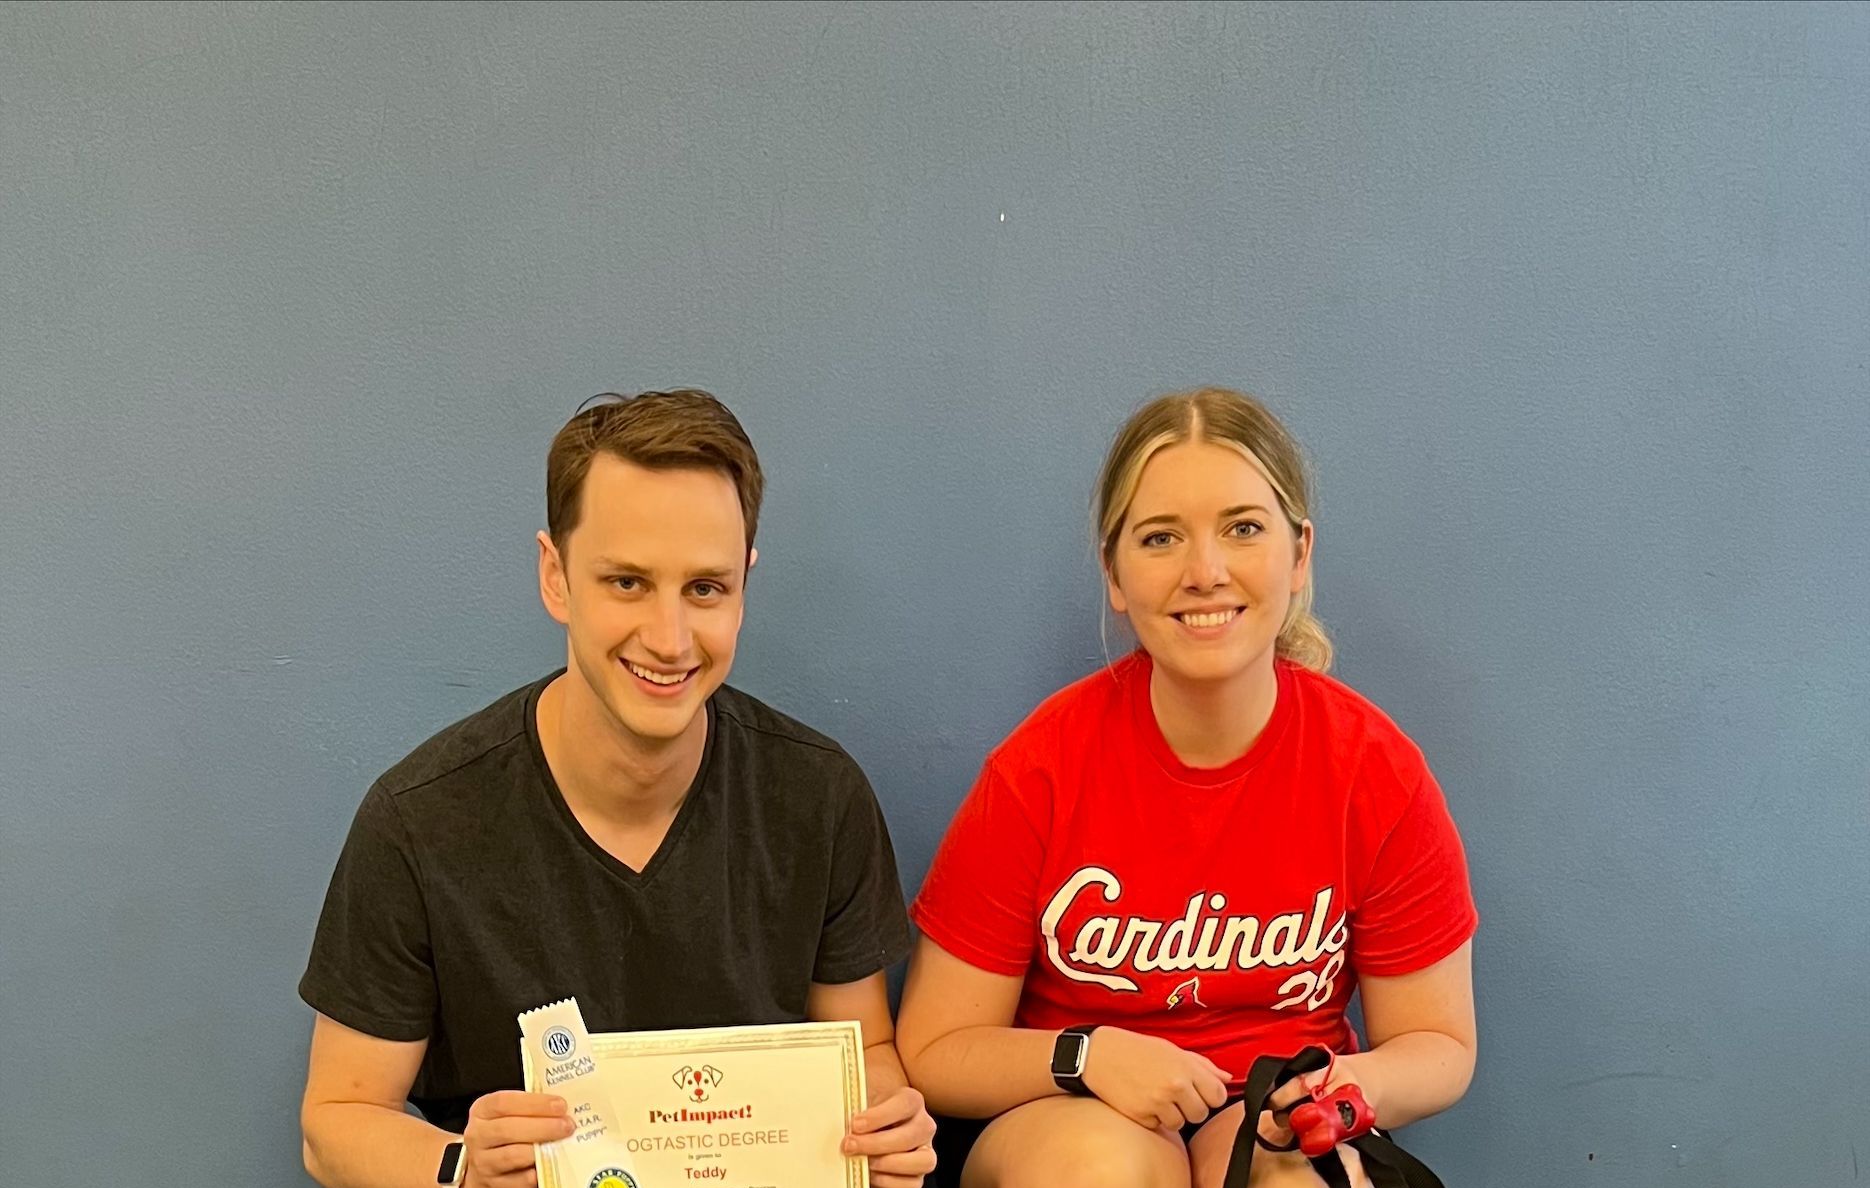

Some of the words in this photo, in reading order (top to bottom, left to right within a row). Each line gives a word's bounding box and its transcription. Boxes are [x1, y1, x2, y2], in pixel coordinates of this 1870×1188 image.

[1041, 866, 1348, 993] Cardinals
[548, 1032, 570, 1056] AKC
[545, 1055, 592, 1077] AMERICAN
[573, 1103, 592, 1114] AKC
[649, 1104, 752, 1124] PetImpact!
[626, 1134, 714, 1154] OGTASTIC
[718, 1129, 790, 1147] DEGREE
[695, 1152, 713, 1161] given
[684, 1166, 727, 1181] Teddy
